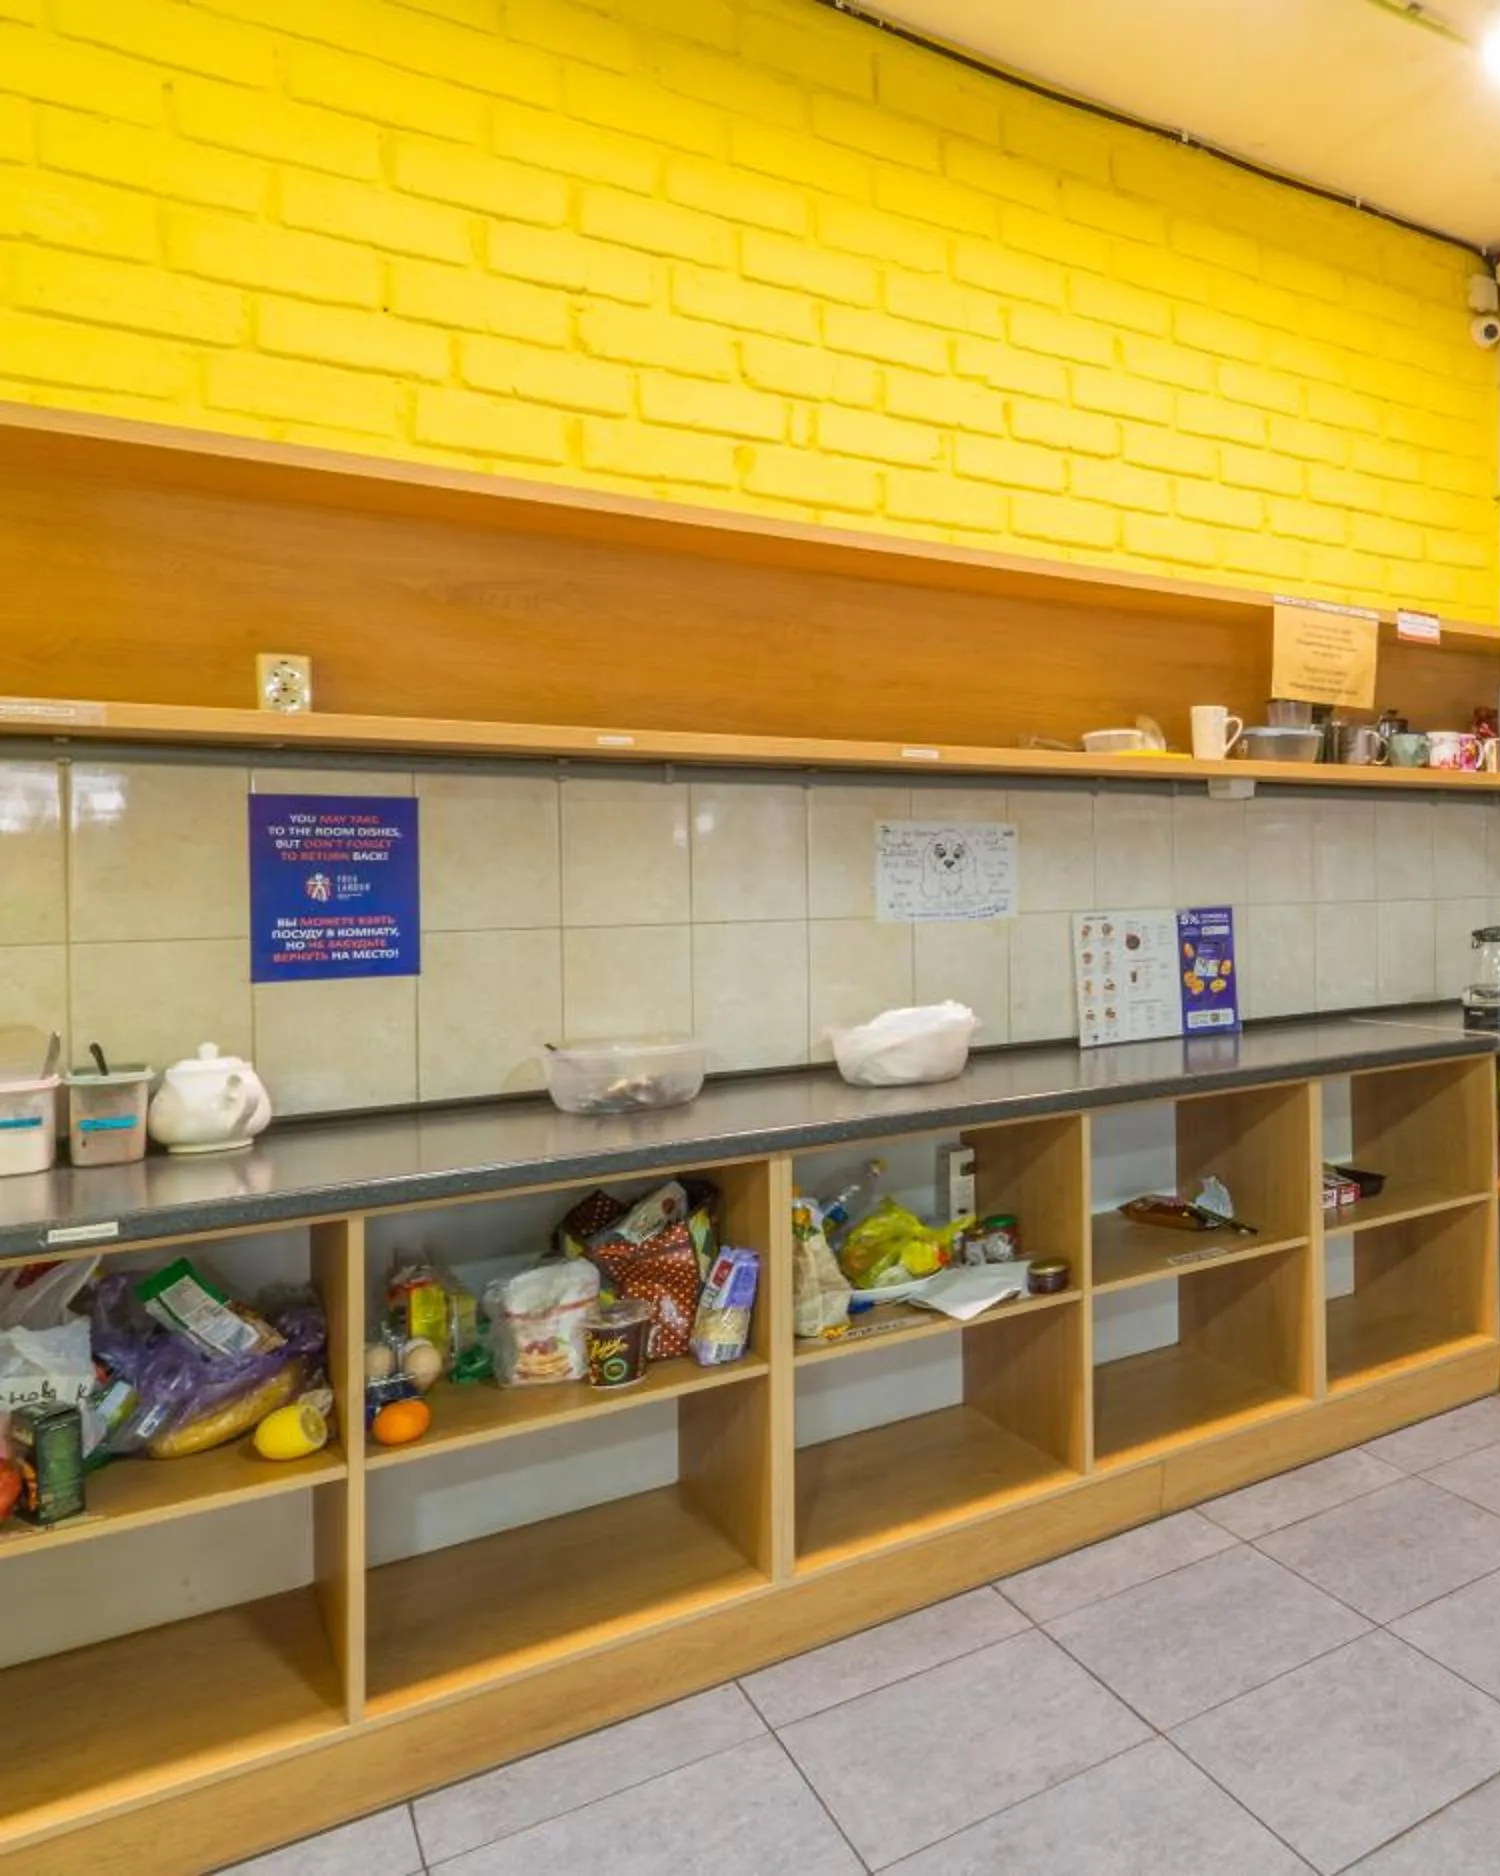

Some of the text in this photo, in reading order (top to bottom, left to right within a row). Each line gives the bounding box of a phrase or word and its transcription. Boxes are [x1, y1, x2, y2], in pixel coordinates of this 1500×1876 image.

[289, 814, 317, 824] YOU
[320, 815, 346, 824] MAY
[268, 827, 403, 838] TO THE ROOM DISHES,
[275, 839, 302, 849] BUT
[281, 851, 298, 861] TO
[352, 851, 389, 861] BACK!
[277, 918, 297, 928] ВЫ
[300, 916, 356, 927] МОЖЕТЕ
[272, 927, 400, 940] ПОСУДУ В КОМНАТУ,
[285, 940, 305, 950] НО
[331, 951, 350, 961] НА
[352, 949, 400, 960] МЕСТО!
